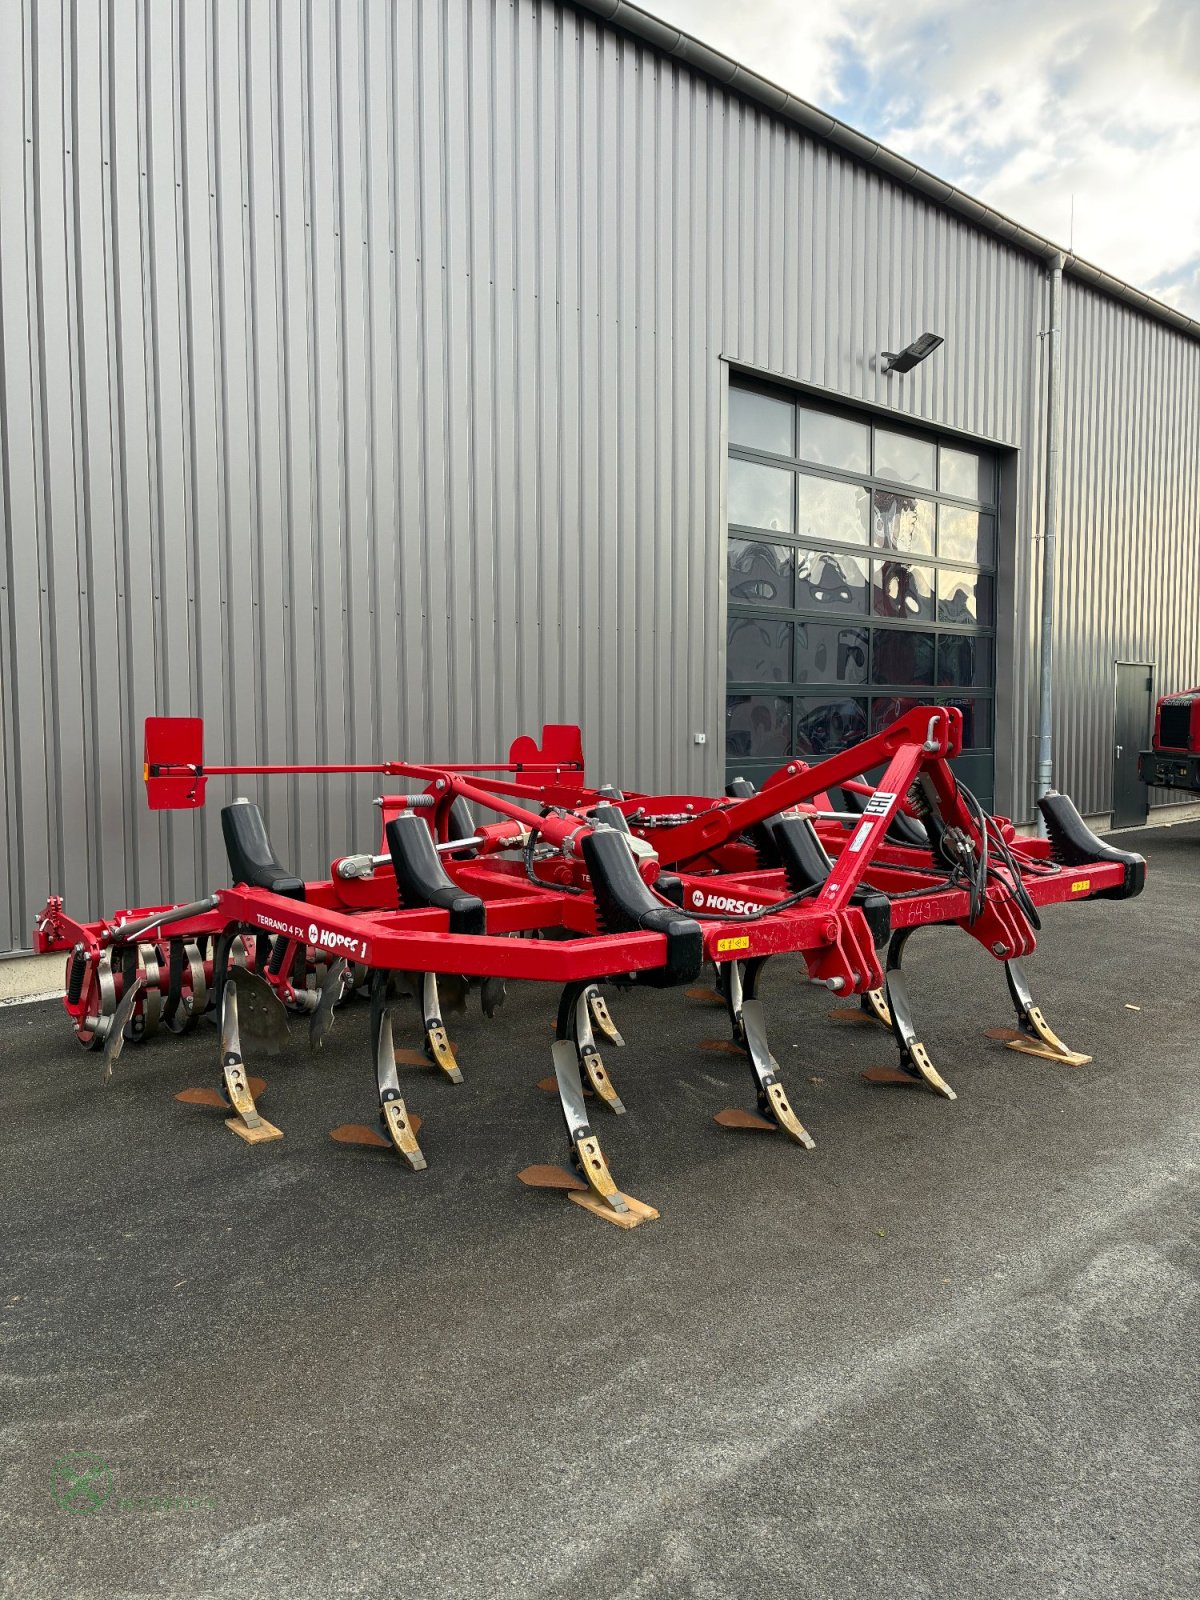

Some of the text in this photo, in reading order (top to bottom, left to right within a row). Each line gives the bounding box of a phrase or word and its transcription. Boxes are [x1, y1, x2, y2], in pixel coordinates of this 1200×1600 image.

[256, 913, 288, 932] TERRANO
[288, 925, 294, 934] 4
[294, 927, 304, 938] FX
